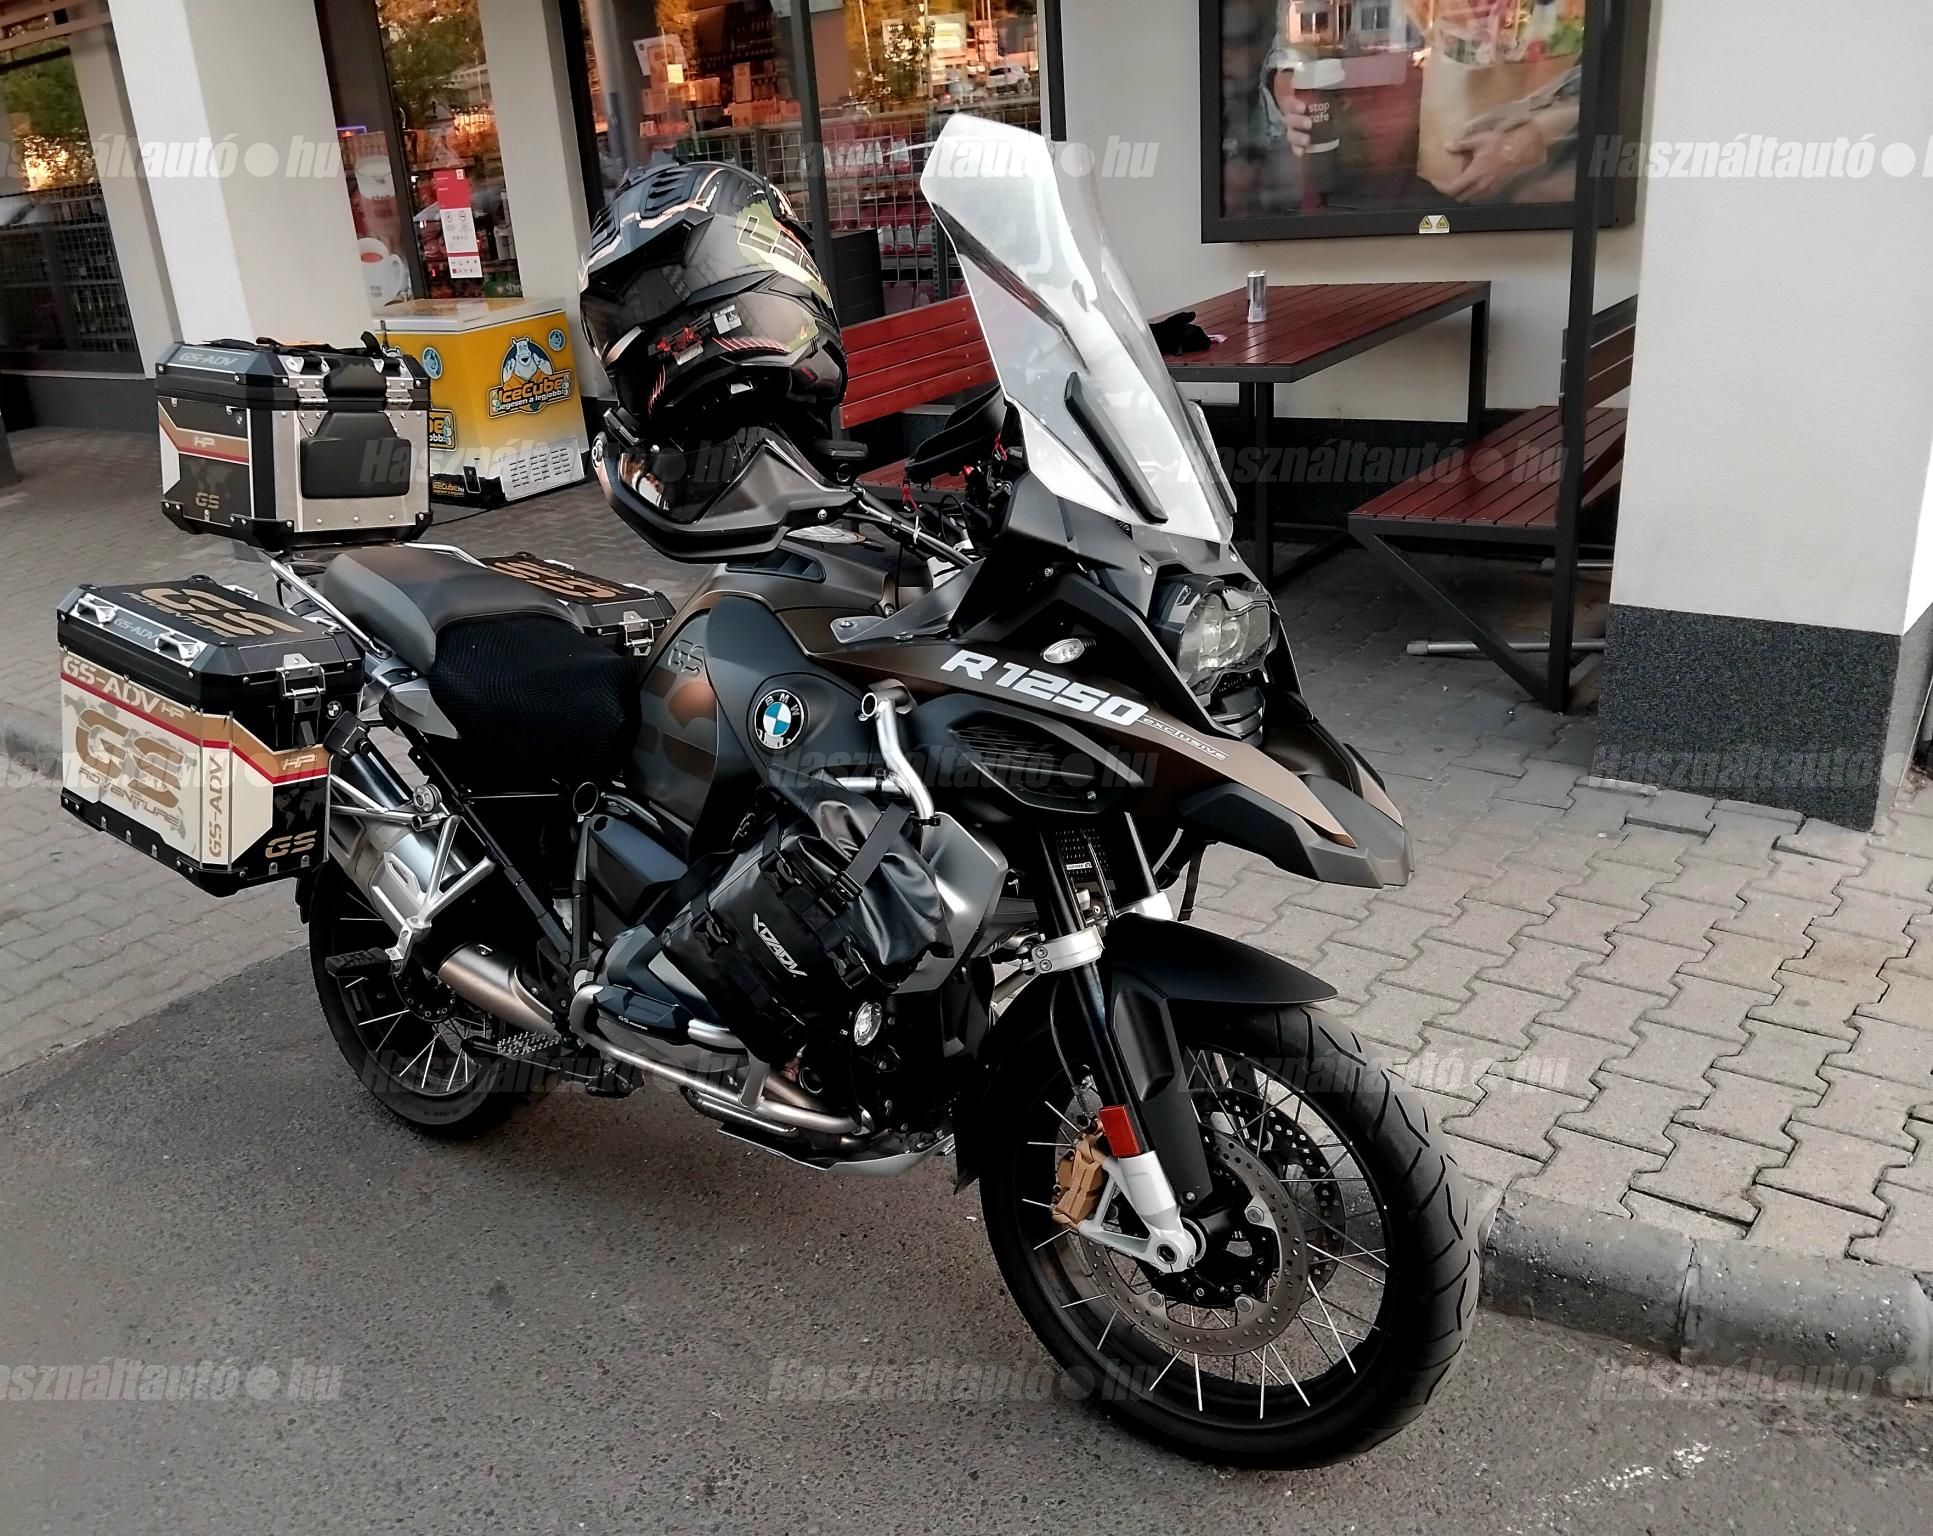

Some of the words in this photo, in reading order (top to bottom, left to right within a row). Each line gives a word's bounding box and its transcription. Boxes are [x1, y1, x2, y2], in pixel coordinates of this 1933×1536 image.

[1308, 102, 1330, 113] stop
[498, 376, 565, 405] IceCube
[193, 436, 216, 448] HP
[195, 491, 221, 510] GS
[113, 617, 159, 641] GS-ADV
[61, 655, 161, 715] GS-ADV
[160, 704, 186, 720] HP
[940, 649, 999, 681] R
[995, 661, 1150, 727] 1250
[764, 692, 801, 717] BMW
[1141, 716, 1229, 762] exclusive
[74, 707, 185, 808] GS
[280, 753, 318, 771] HP
[77, 765, 181, 829] ADVENTURE
[208, 754, 225, 858] GS-ADV
[264, 829, 318, 859] GS
